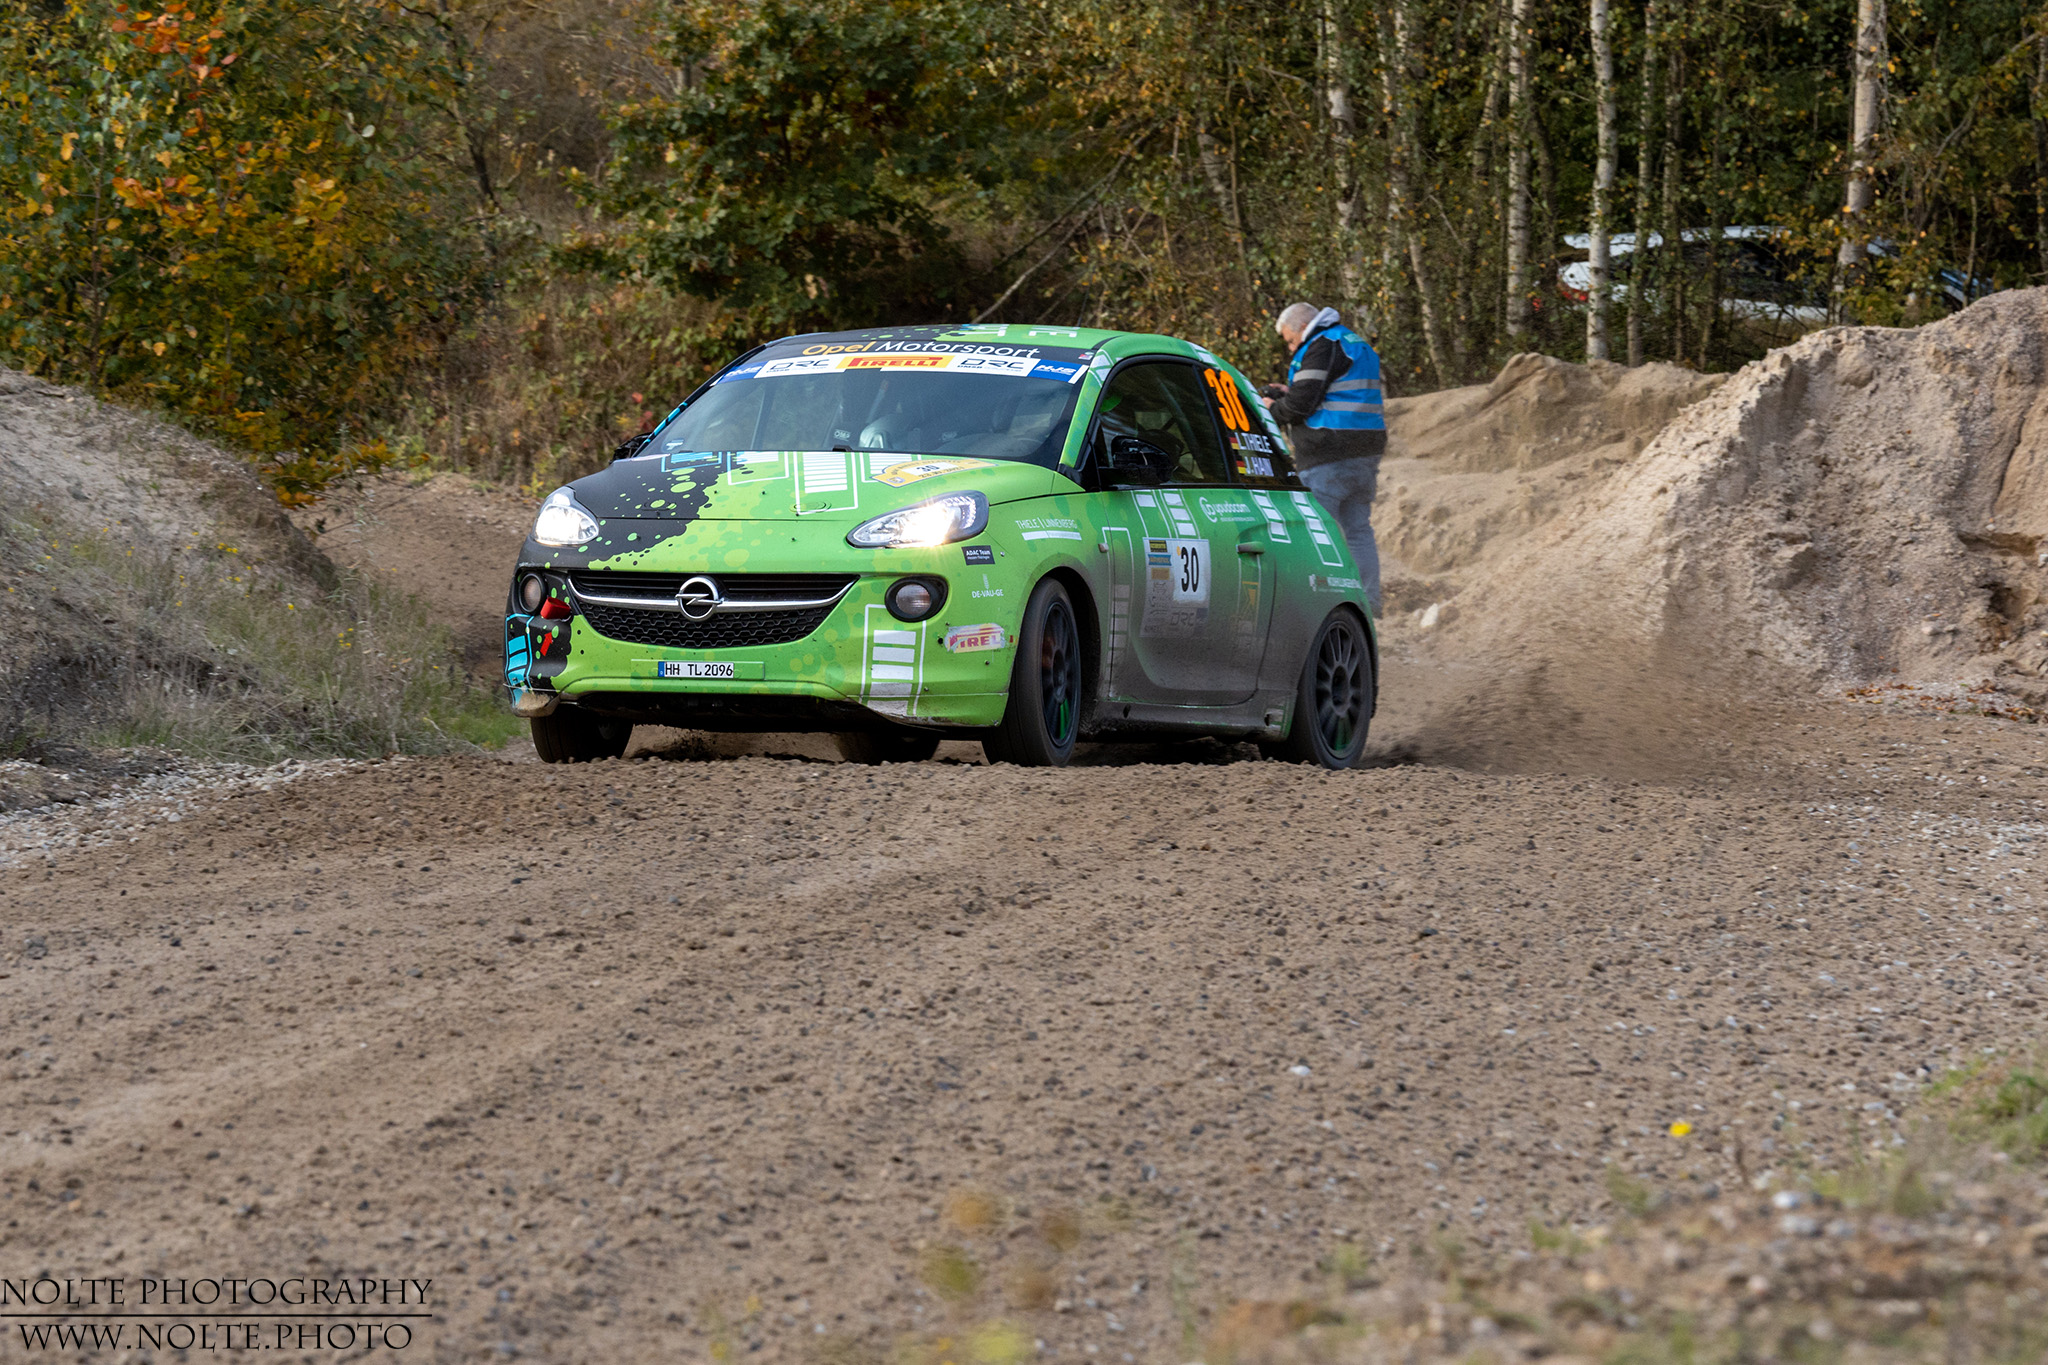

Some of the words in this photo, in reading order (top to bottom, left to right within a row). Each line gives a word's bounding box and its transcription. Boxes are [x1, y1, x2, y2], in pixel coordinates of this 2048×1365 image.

[802, 341, 877, 355] Opel
[875, 341, 1040, 359] Motorsport
[848, 356, 943, 367] PIRELLI
[1204, 368, 1250, 432] 30
[1015, 518, 1040, 529] THIELE
[1181, 546, 1199, 592] 30
[972, 589, 1004, 598] DE-VAU-GE
[665, 663, 680, 675] HH
[688, 663, 702, 676] TL
[704, 664, 734, 676] 2096
